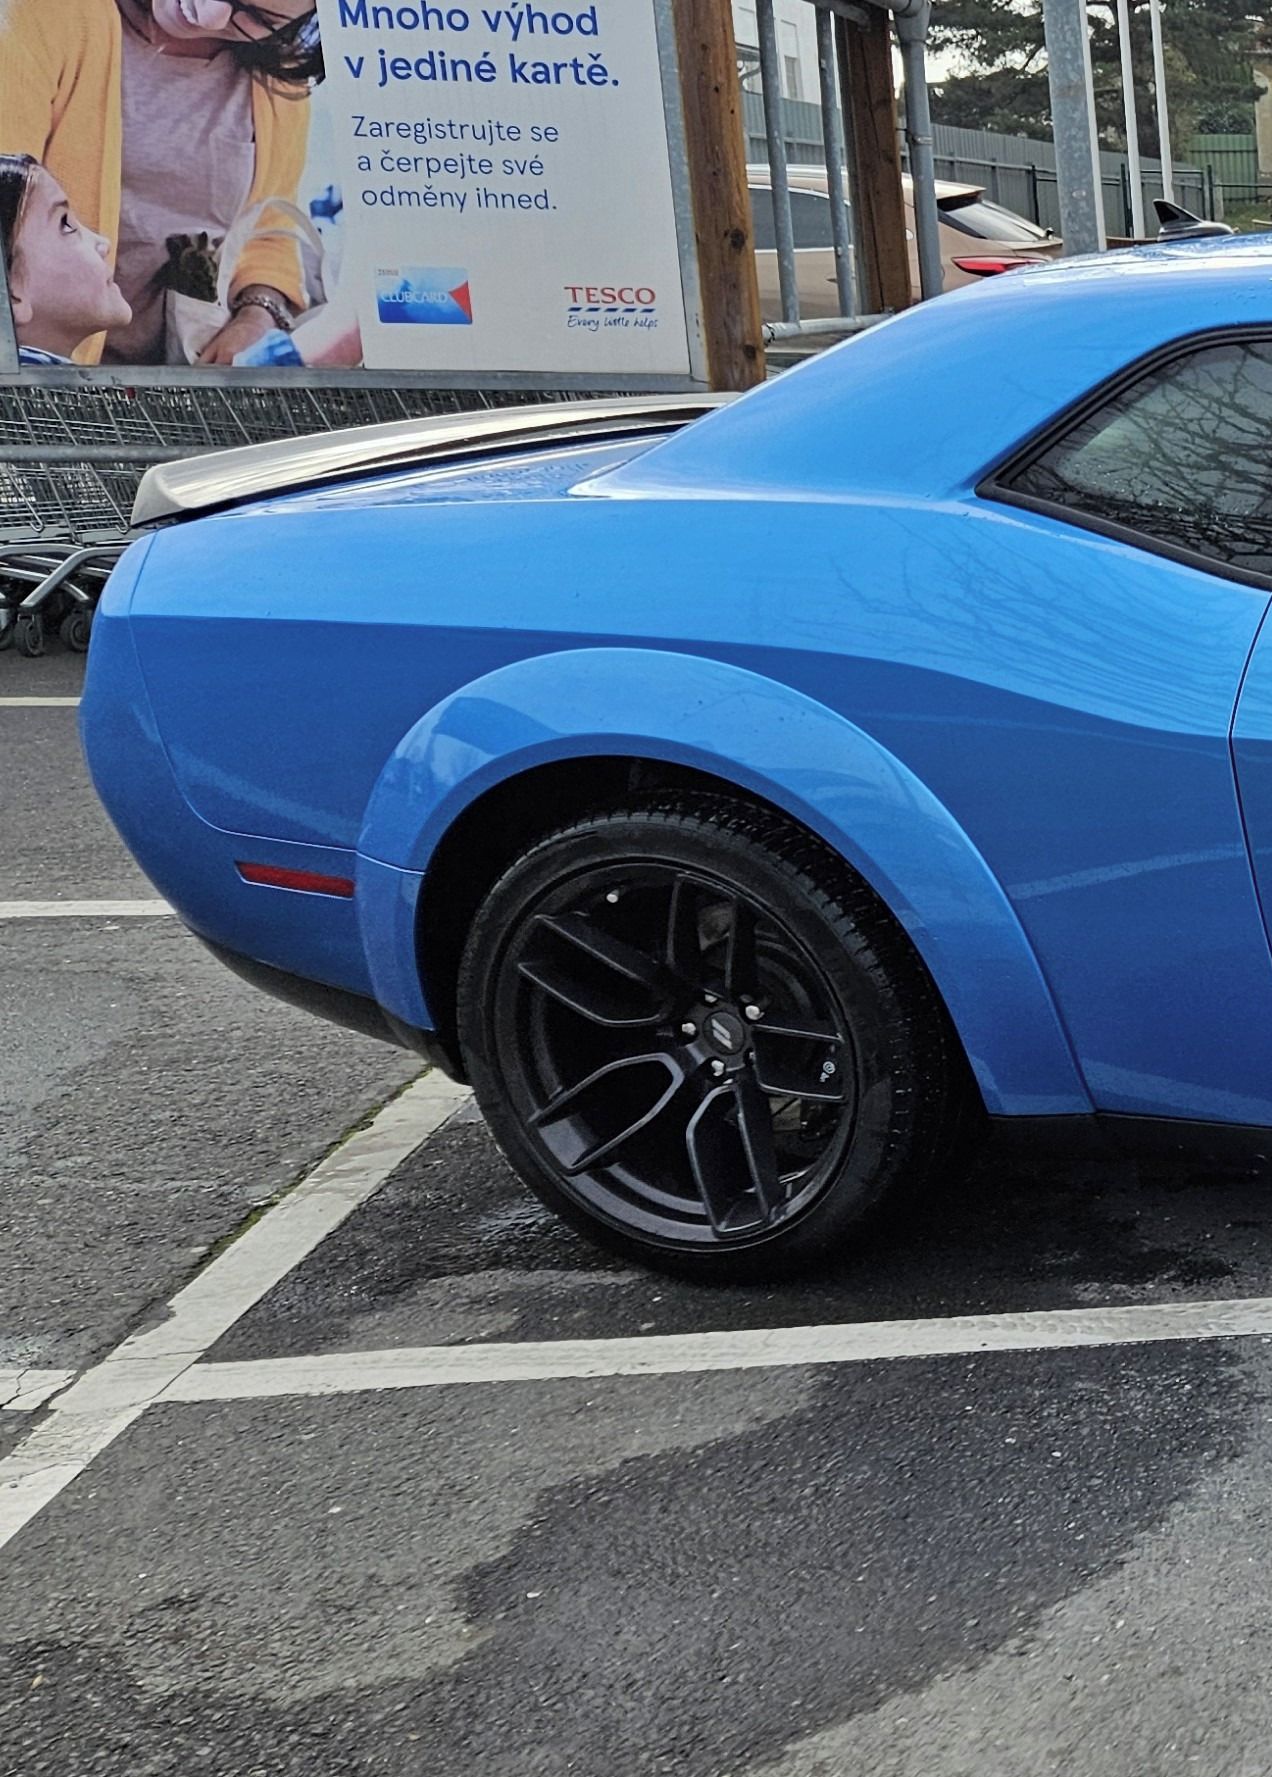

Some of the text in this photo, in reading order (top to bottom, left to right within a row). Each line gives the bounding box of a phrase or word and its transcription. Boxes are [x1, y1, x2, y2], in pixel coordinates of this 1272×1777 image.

[338, 0, 599, 42] Mnoho výhod
[344, 49, 620, 87] v jediné kartě.
[351, 115, 559, 146] Zaregistrujte se
[357, 150, 544, 179] a čerpejte své
[362, 184, 557, 213] odměny ihned.
[563, 286, 656, 304] TESCO
[567, 315, 600, 332] Every
[634, 317, 659, 331] helps
